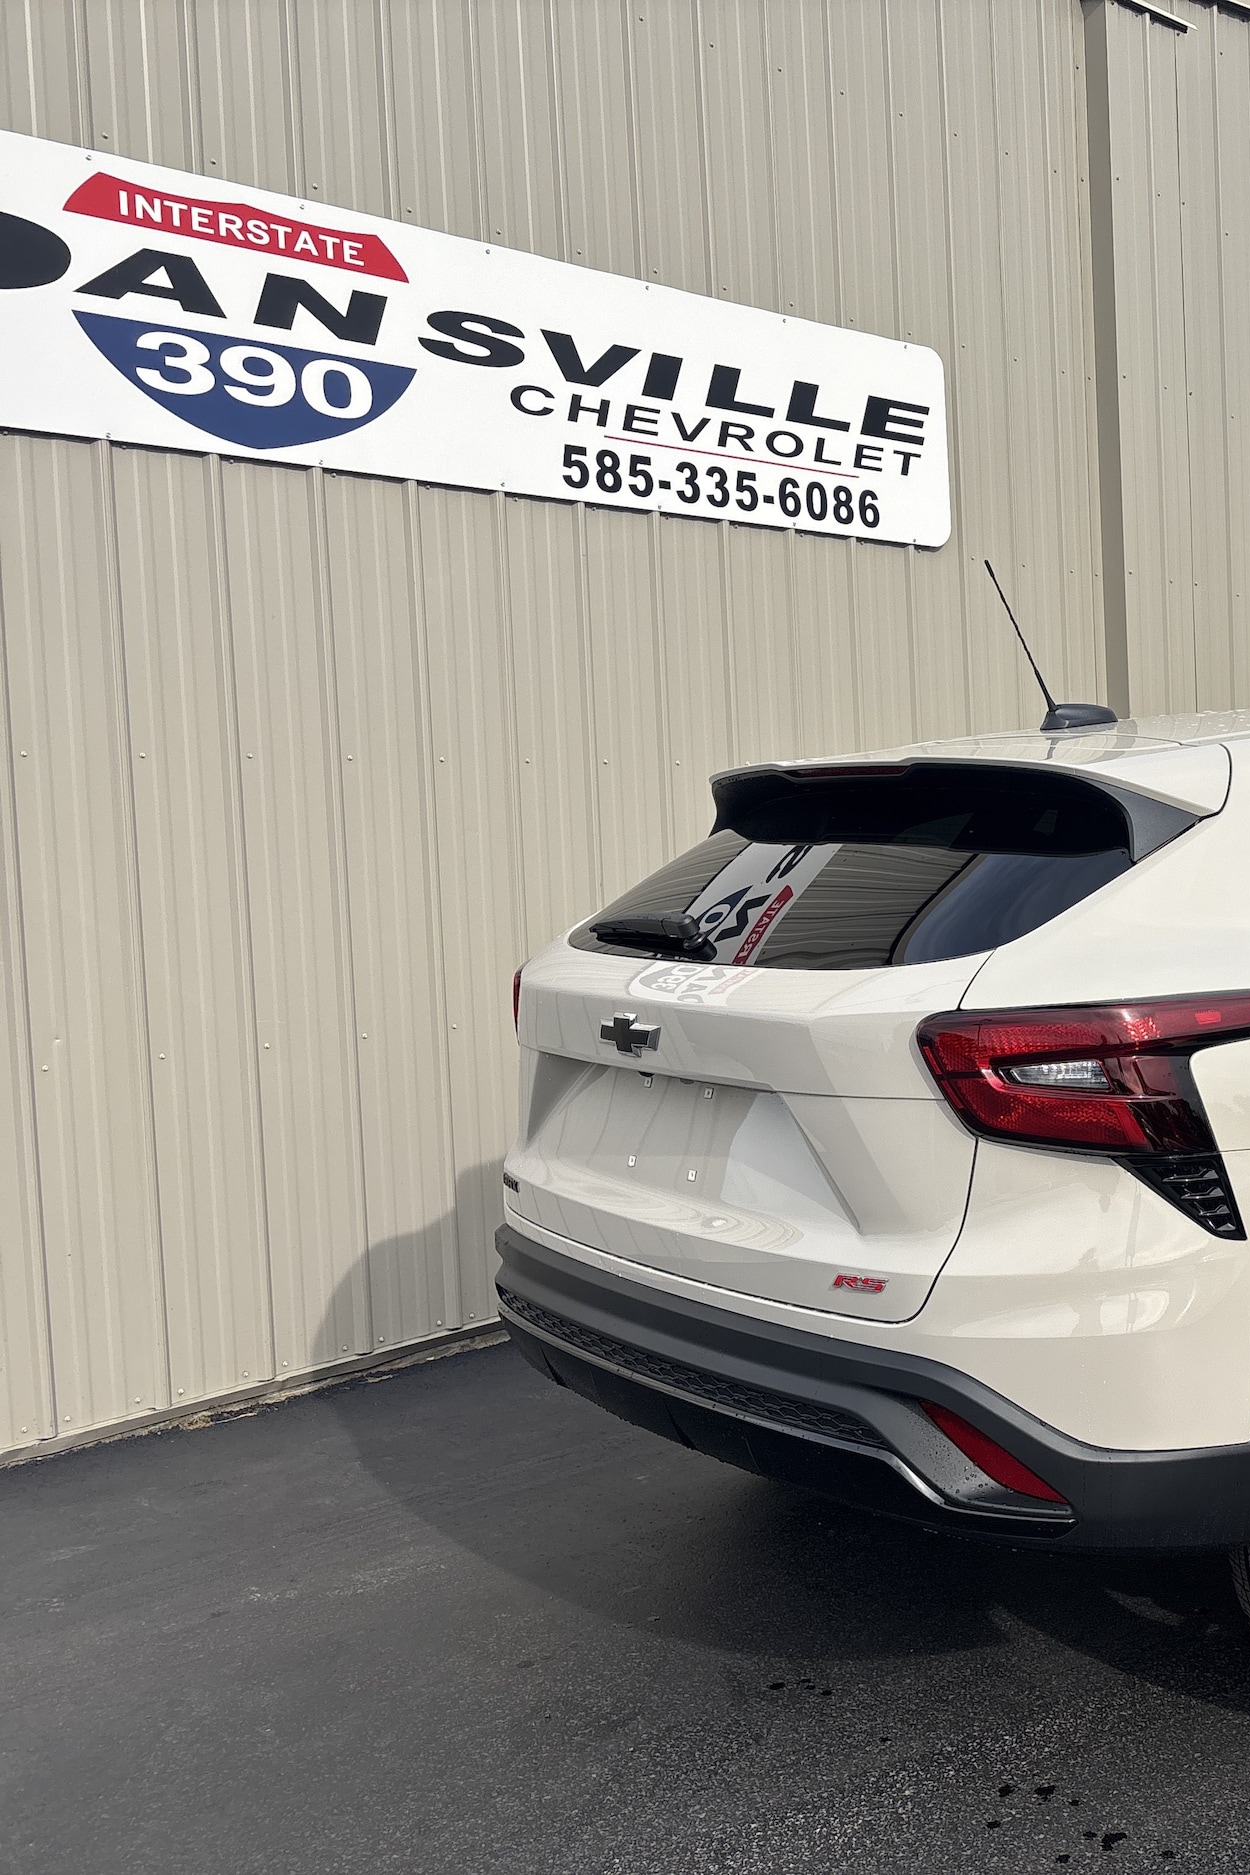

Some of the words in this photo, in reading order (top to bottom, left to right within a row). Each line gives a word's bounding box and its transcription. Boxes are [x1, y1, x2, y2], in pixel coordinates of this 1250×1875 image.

[118, 189, 365, 266] INTERSTATE
[135, 331, 373, 420] 390
[509, 384, 922, 477] CHEVROLET
[562, 444, 881, 529] 585-335-6086
[832, 1272, 889, 1294] RS
